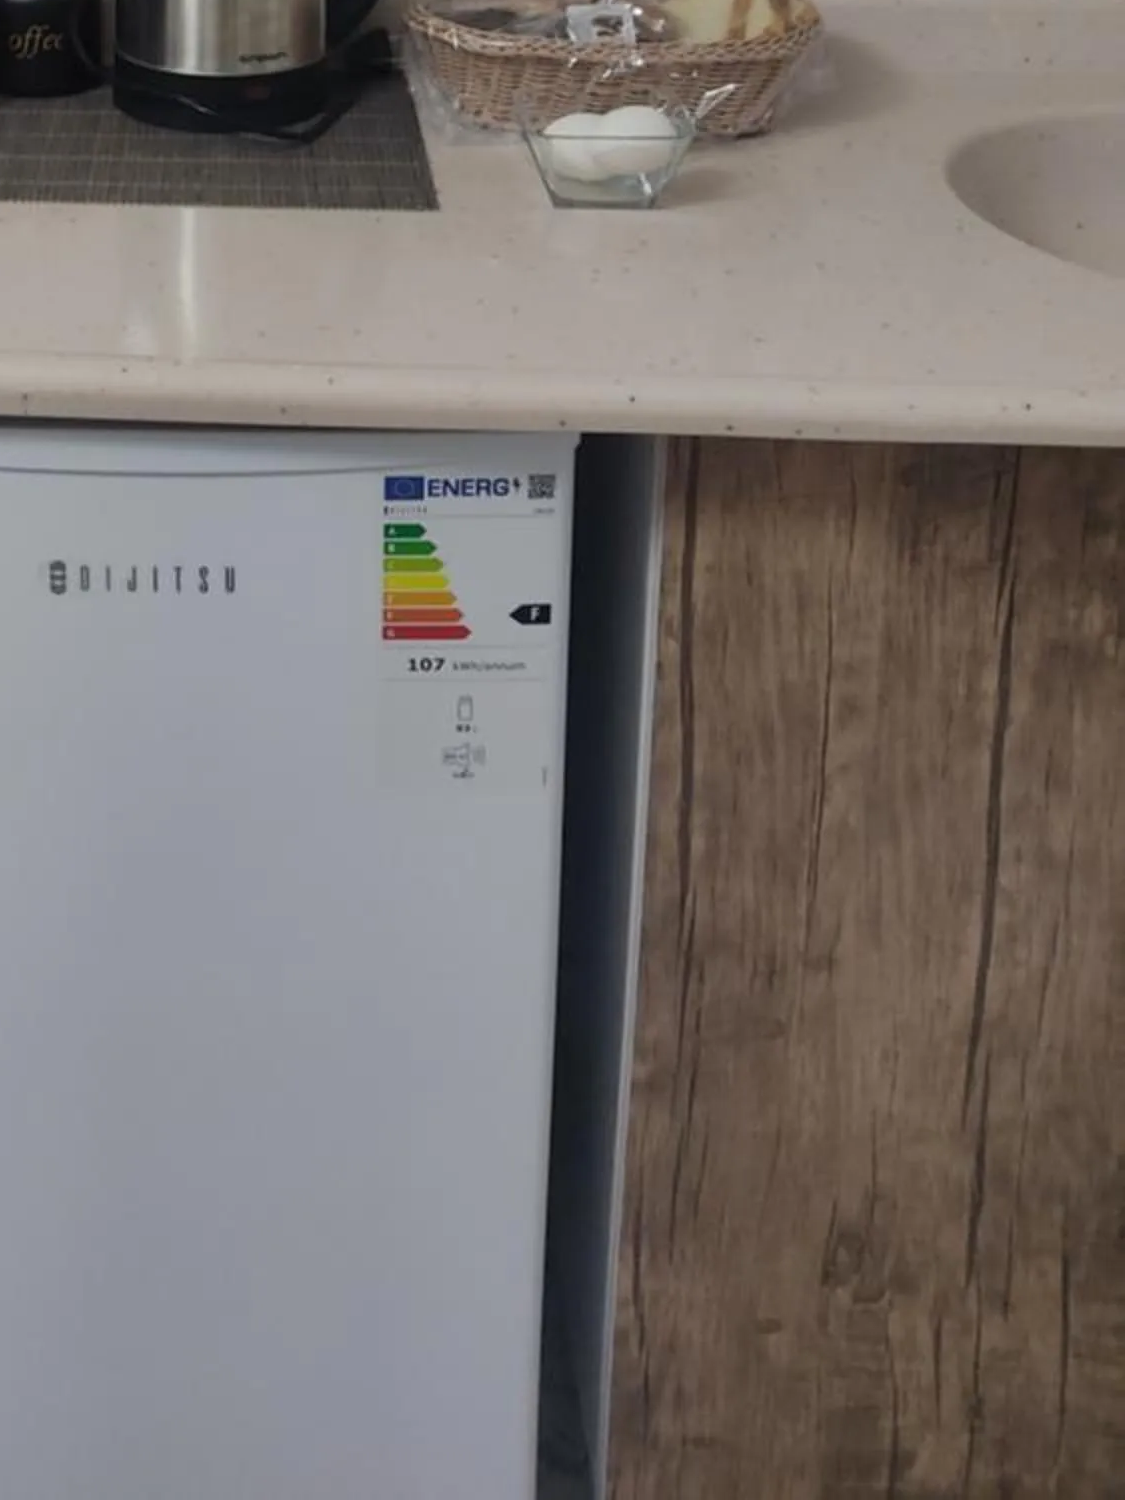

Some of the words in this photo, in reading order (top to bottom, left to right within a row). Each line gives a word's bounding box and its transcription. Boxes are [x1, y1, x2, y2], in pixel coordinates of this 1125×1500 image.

[427, 477, 510, 497] ENERG
[79, 564, 236, 594] DIJITSU
[530, 607, 540, 621] F
[407, 657, 446, 672] 107
